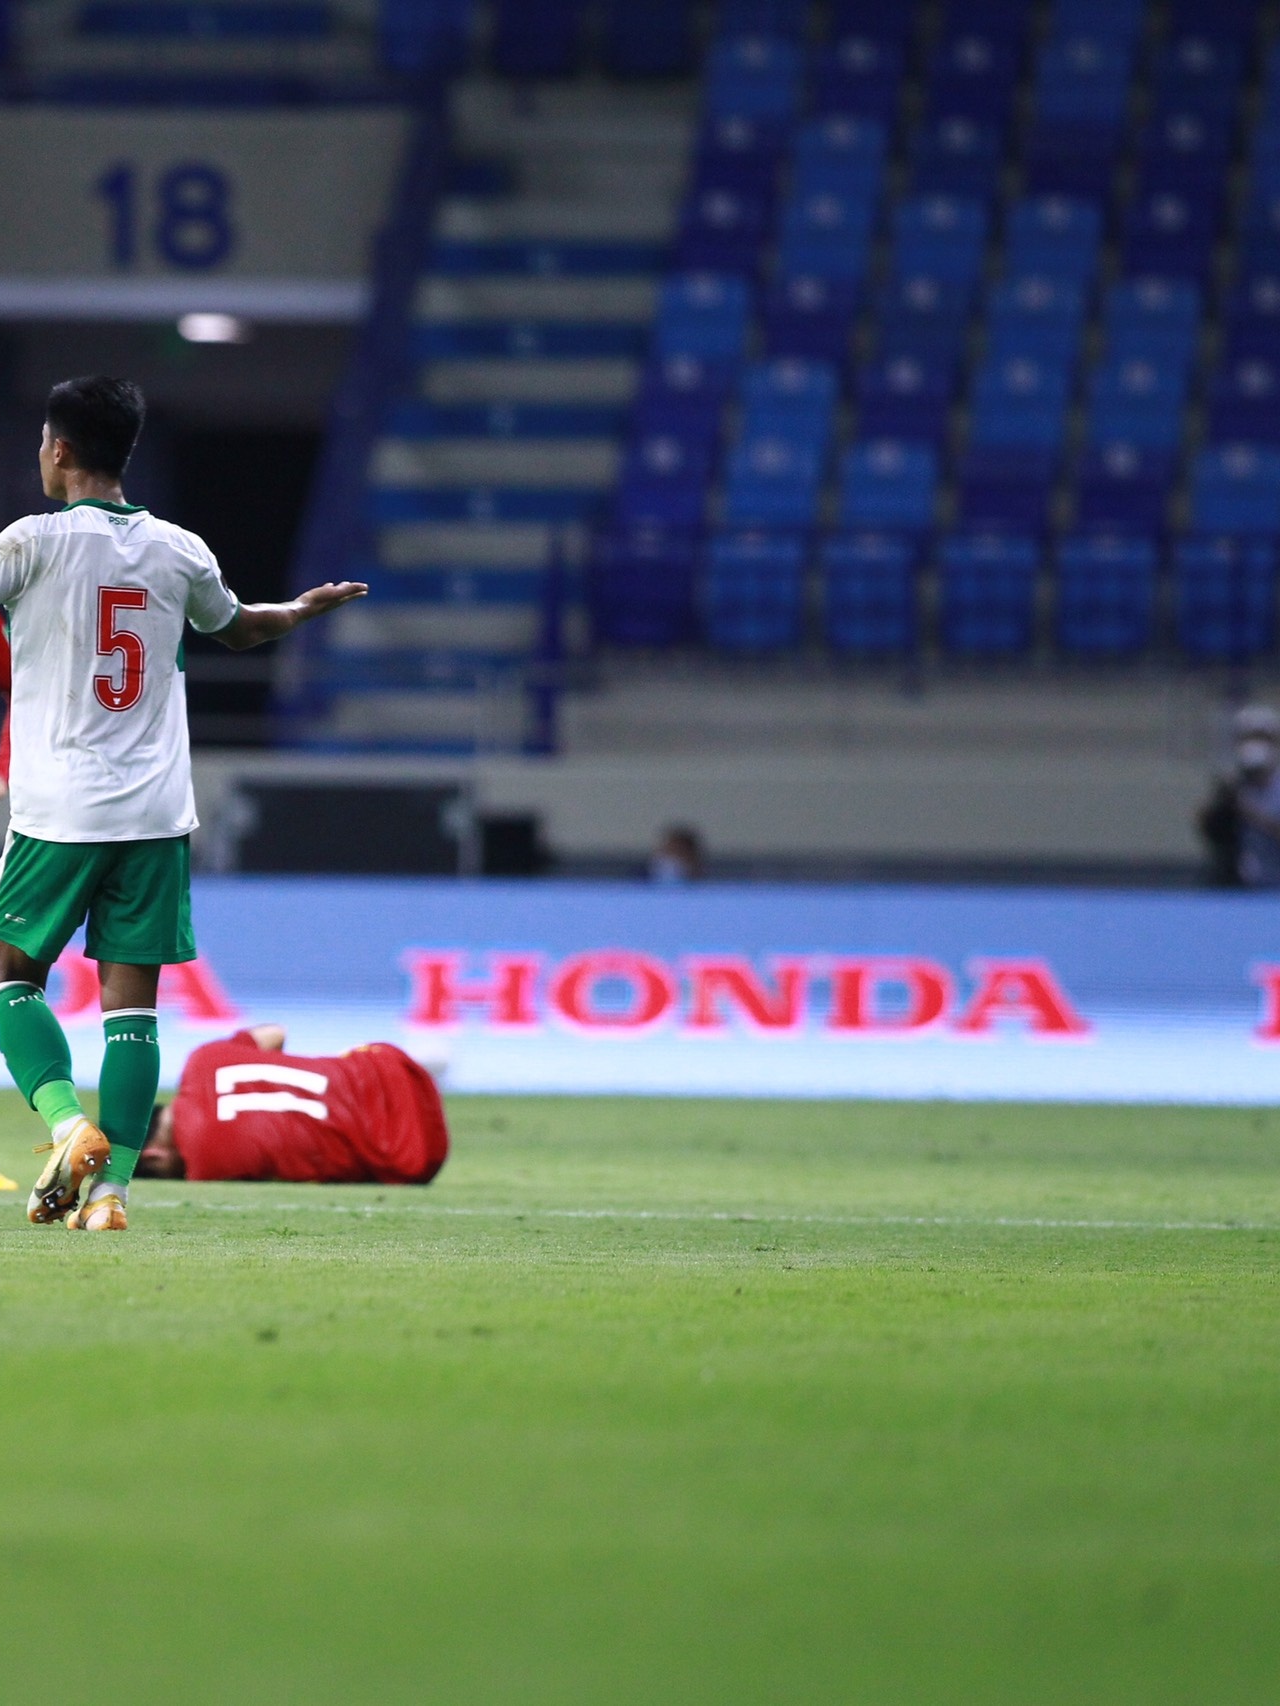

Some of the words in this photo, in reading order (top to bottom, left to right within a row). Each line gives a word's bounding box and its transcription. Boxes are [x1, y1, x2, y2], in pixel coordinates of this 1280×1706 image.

[92, 162, 234, 274] 18
[108, 516, 129, 526] PSSI
[93, 586, 148, 712] 5
[402, 948, 1092, 1041] HONDA
[216, 1063, 328, 1121] 11
